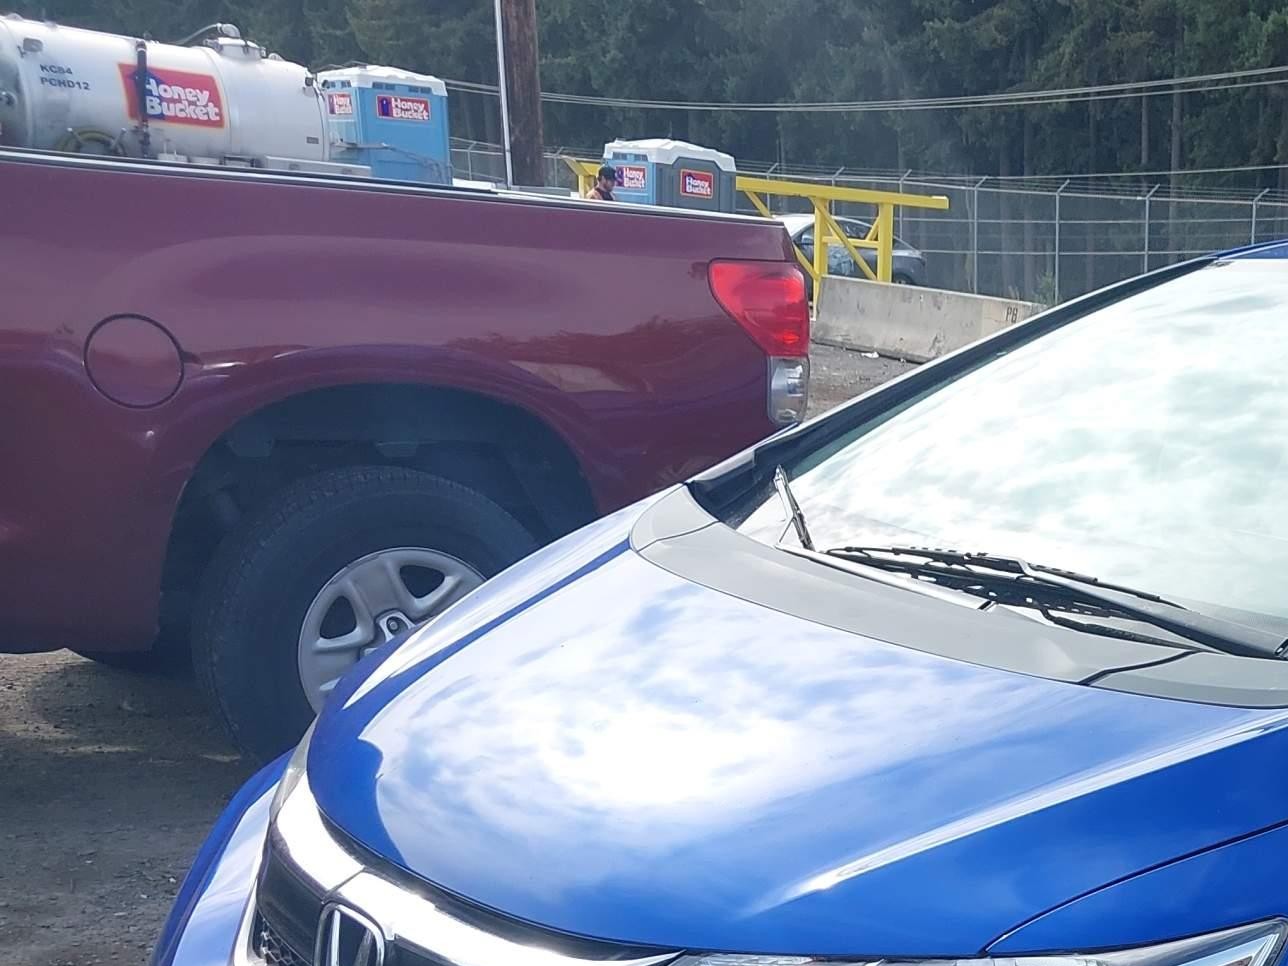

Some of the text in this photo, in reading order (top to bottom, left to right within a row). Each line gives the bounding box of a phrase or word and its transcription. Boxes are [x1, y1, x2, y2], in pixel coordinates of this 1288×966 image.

[146, 78, 210, 106] Honey
[146, 96, 220, 121] Bucket
[391, 97, 425, 113] Honey
